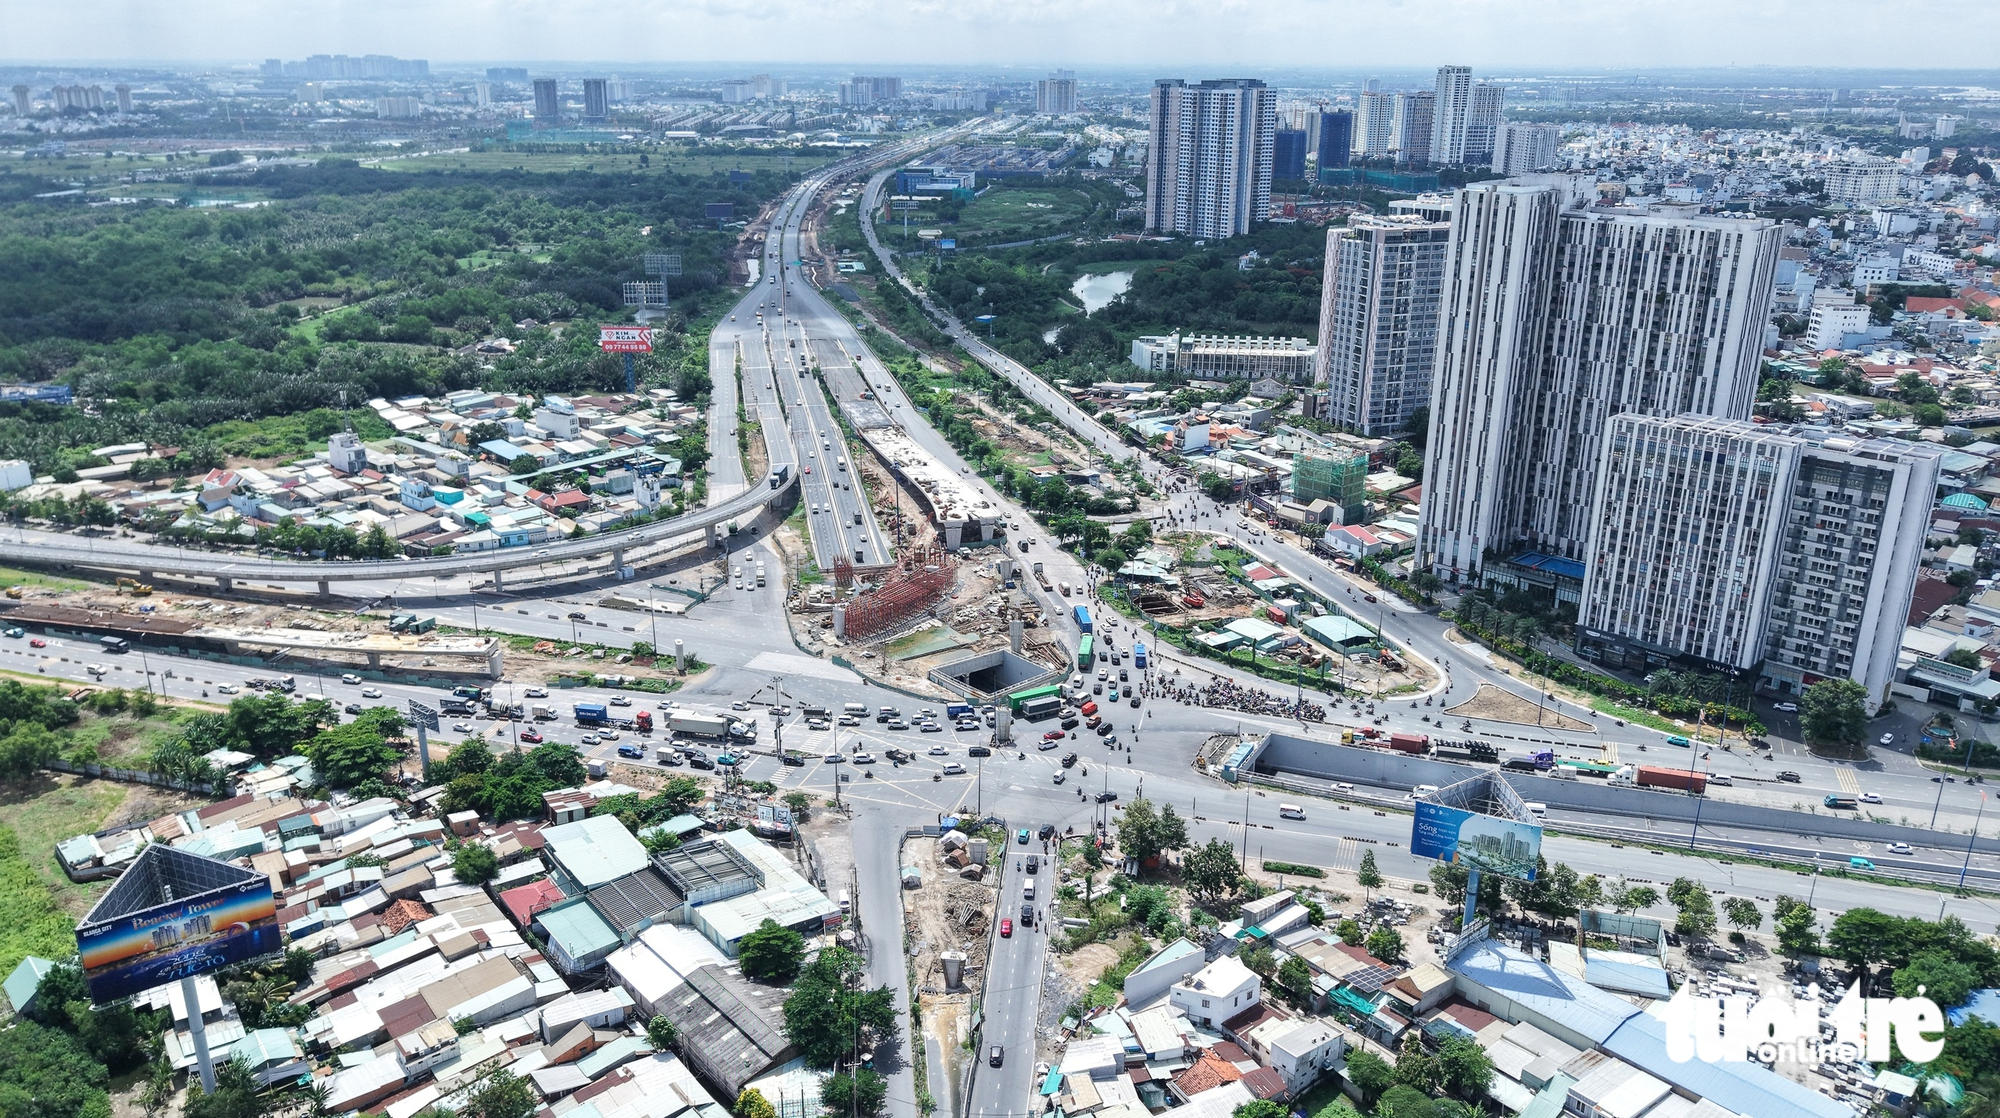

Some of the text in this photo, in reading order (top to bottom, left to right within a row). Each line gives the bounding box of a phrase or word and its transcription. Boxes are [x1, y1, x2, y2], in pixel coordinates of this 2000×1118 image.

[1418, 822, 1438, 834] Sống
[132, 897, 227, 930] Beacon Tower
